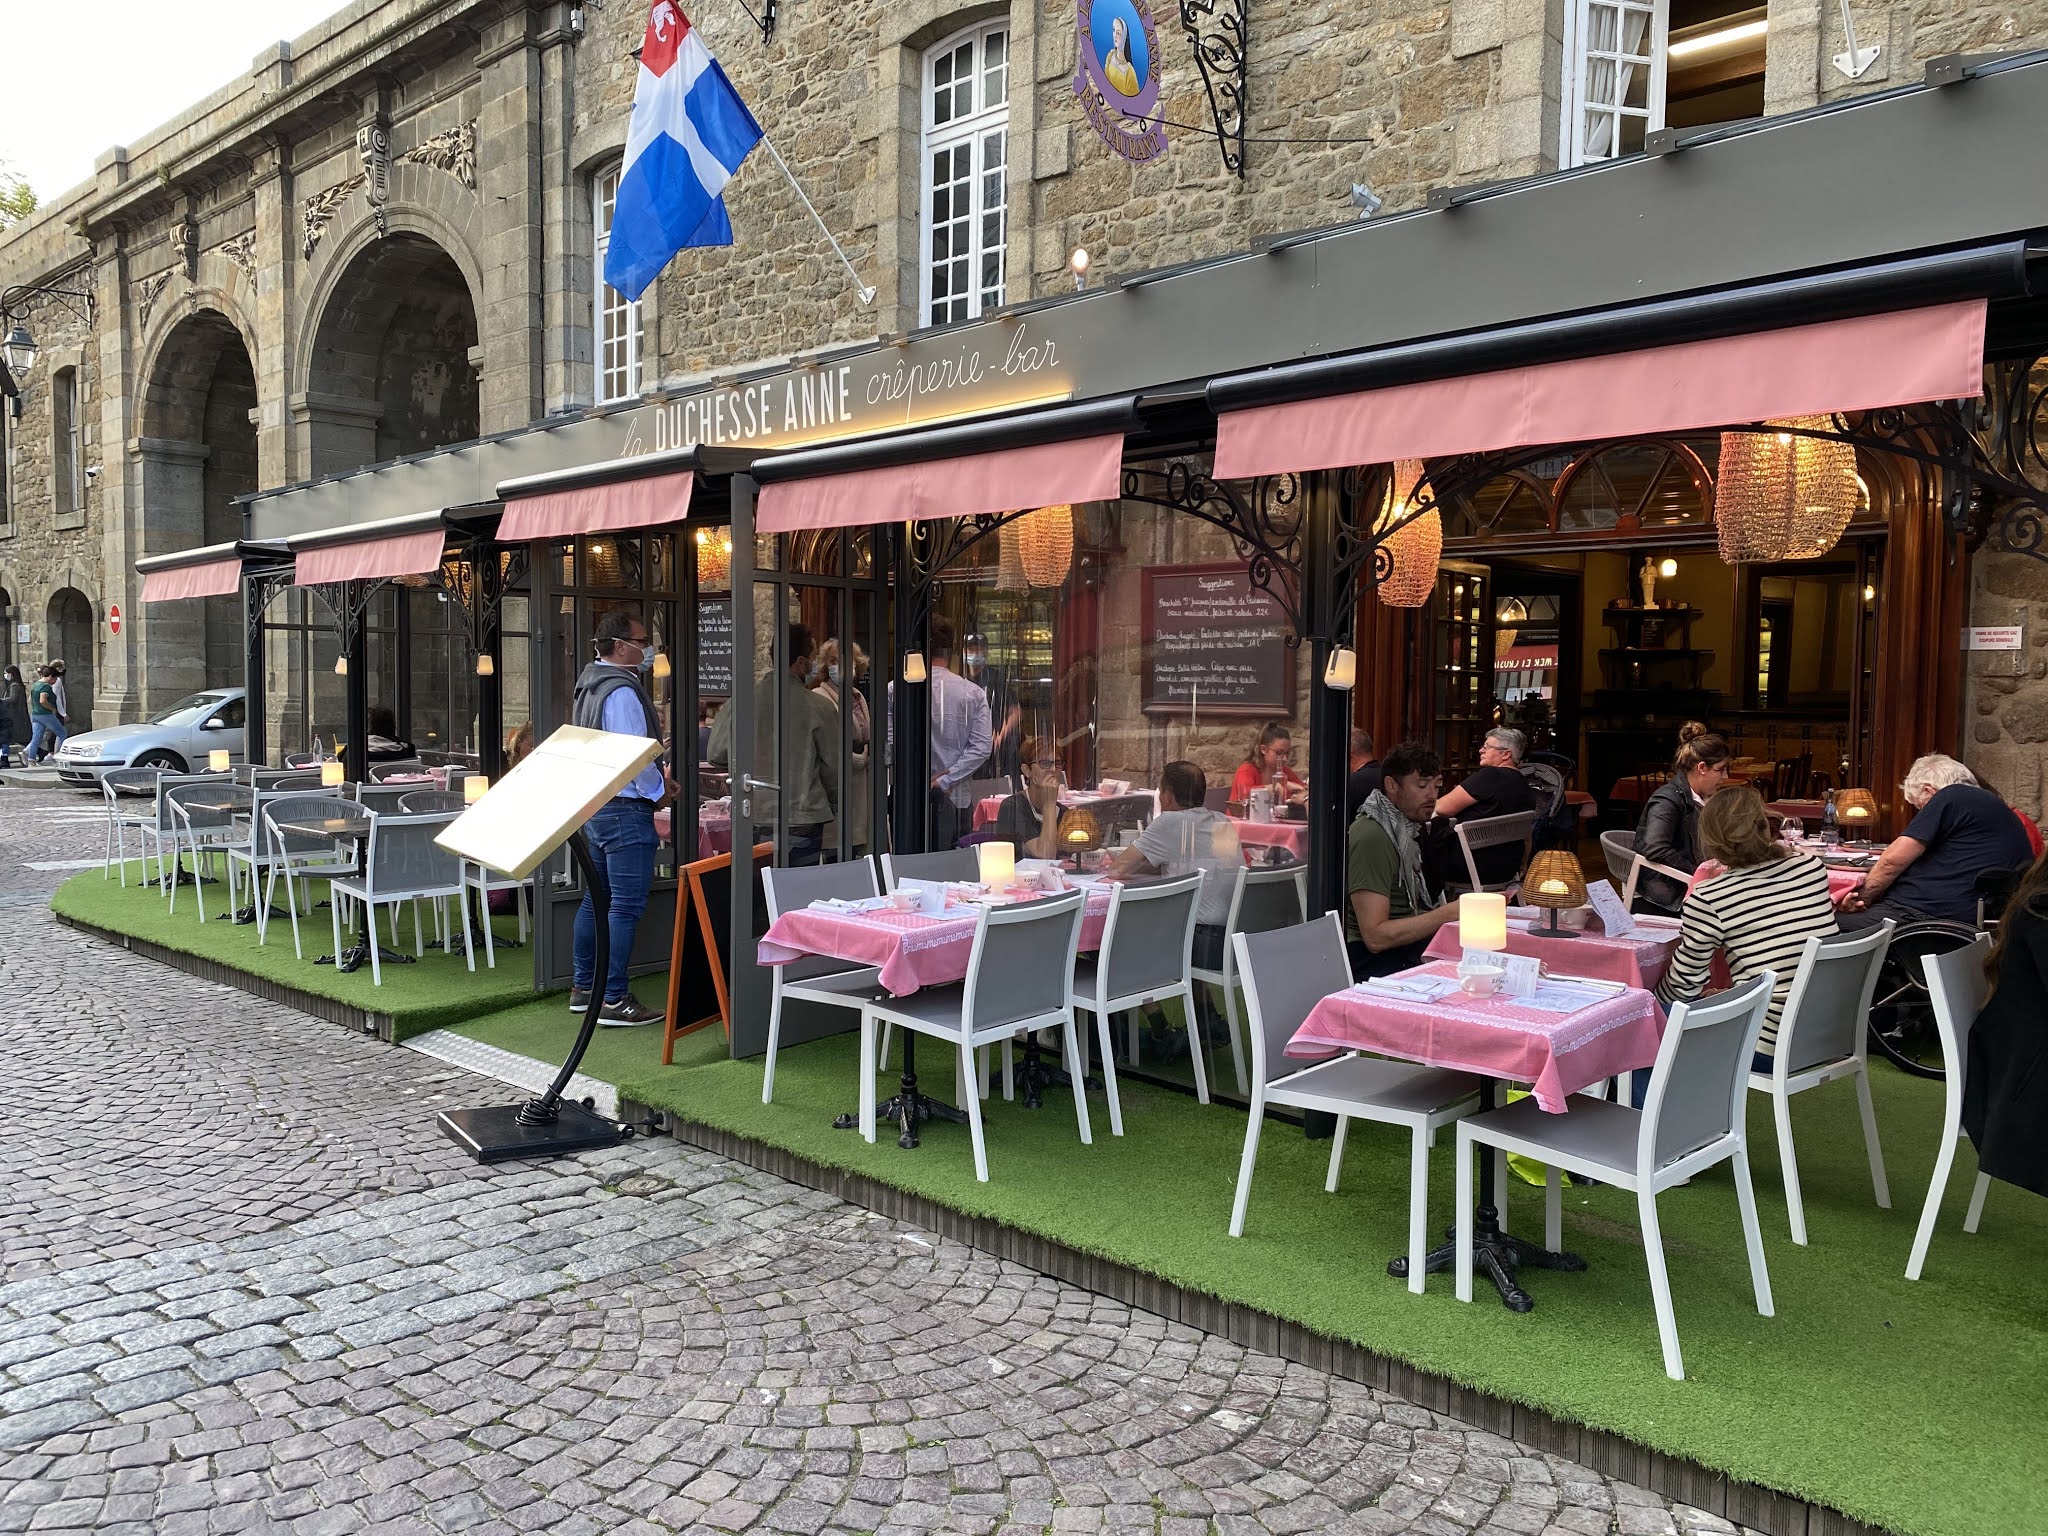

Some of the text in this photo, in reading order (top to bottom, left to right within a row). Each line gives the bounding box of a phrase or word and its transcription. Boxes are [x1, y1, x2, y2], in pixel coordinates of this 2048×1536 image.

[1145, 27, 1159, 83] ANNE
[1080, 83, 1161, 160] RESTAURANT
[620, 417, 648, 457] la
[655, 384, 772, 452] DUCHESSE
[784, 365, 852, 432] ANNE
[1198, 577, 1235, 591] Suggestions
[1256, 607, 1269, 617] 22€
